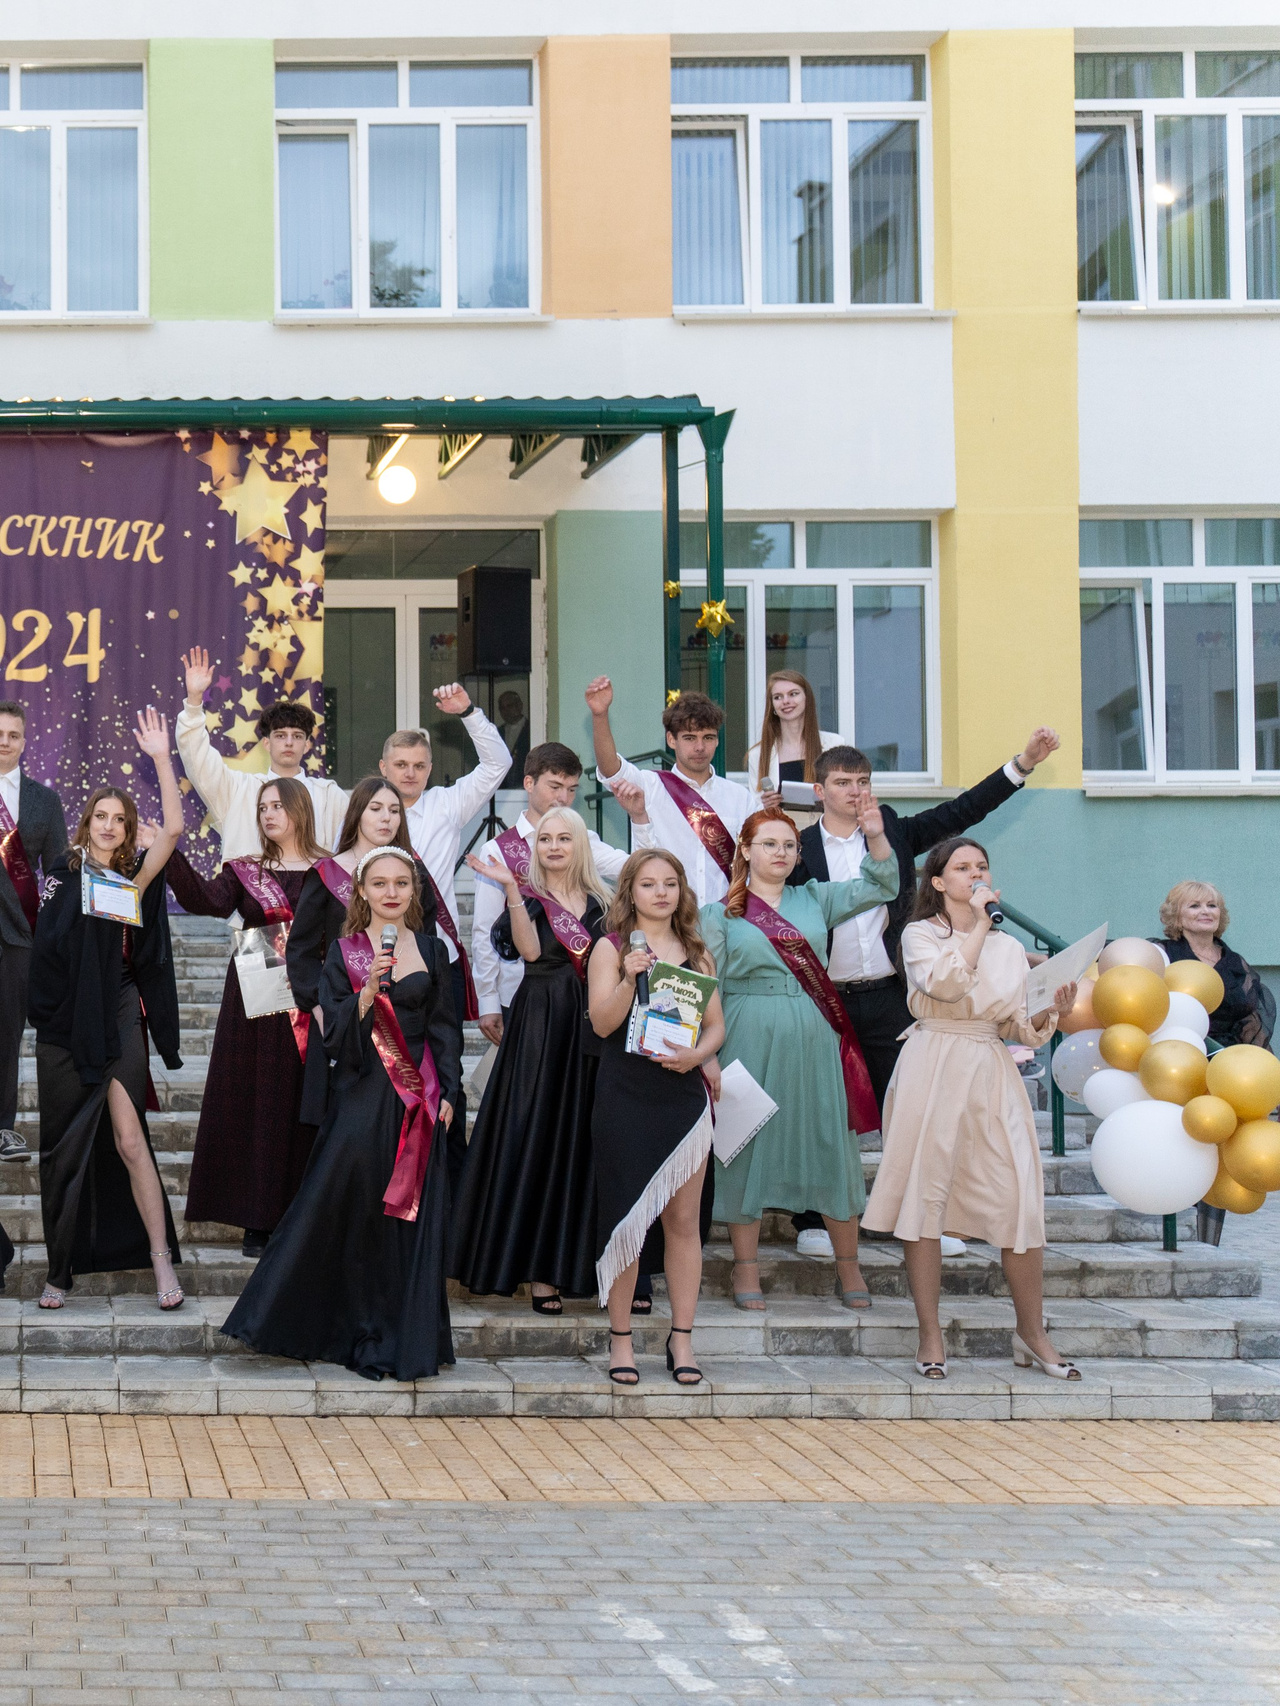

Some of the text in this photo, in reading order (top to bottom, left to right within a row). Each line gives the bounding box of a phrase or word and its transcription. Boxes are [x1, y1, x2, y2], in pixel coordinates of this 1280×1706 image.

[777, 927, 827, 998] Выпускница
[660, 982, 698, 1000] ГРАМОТА
[396, 1060, 423, 1093] 2024
